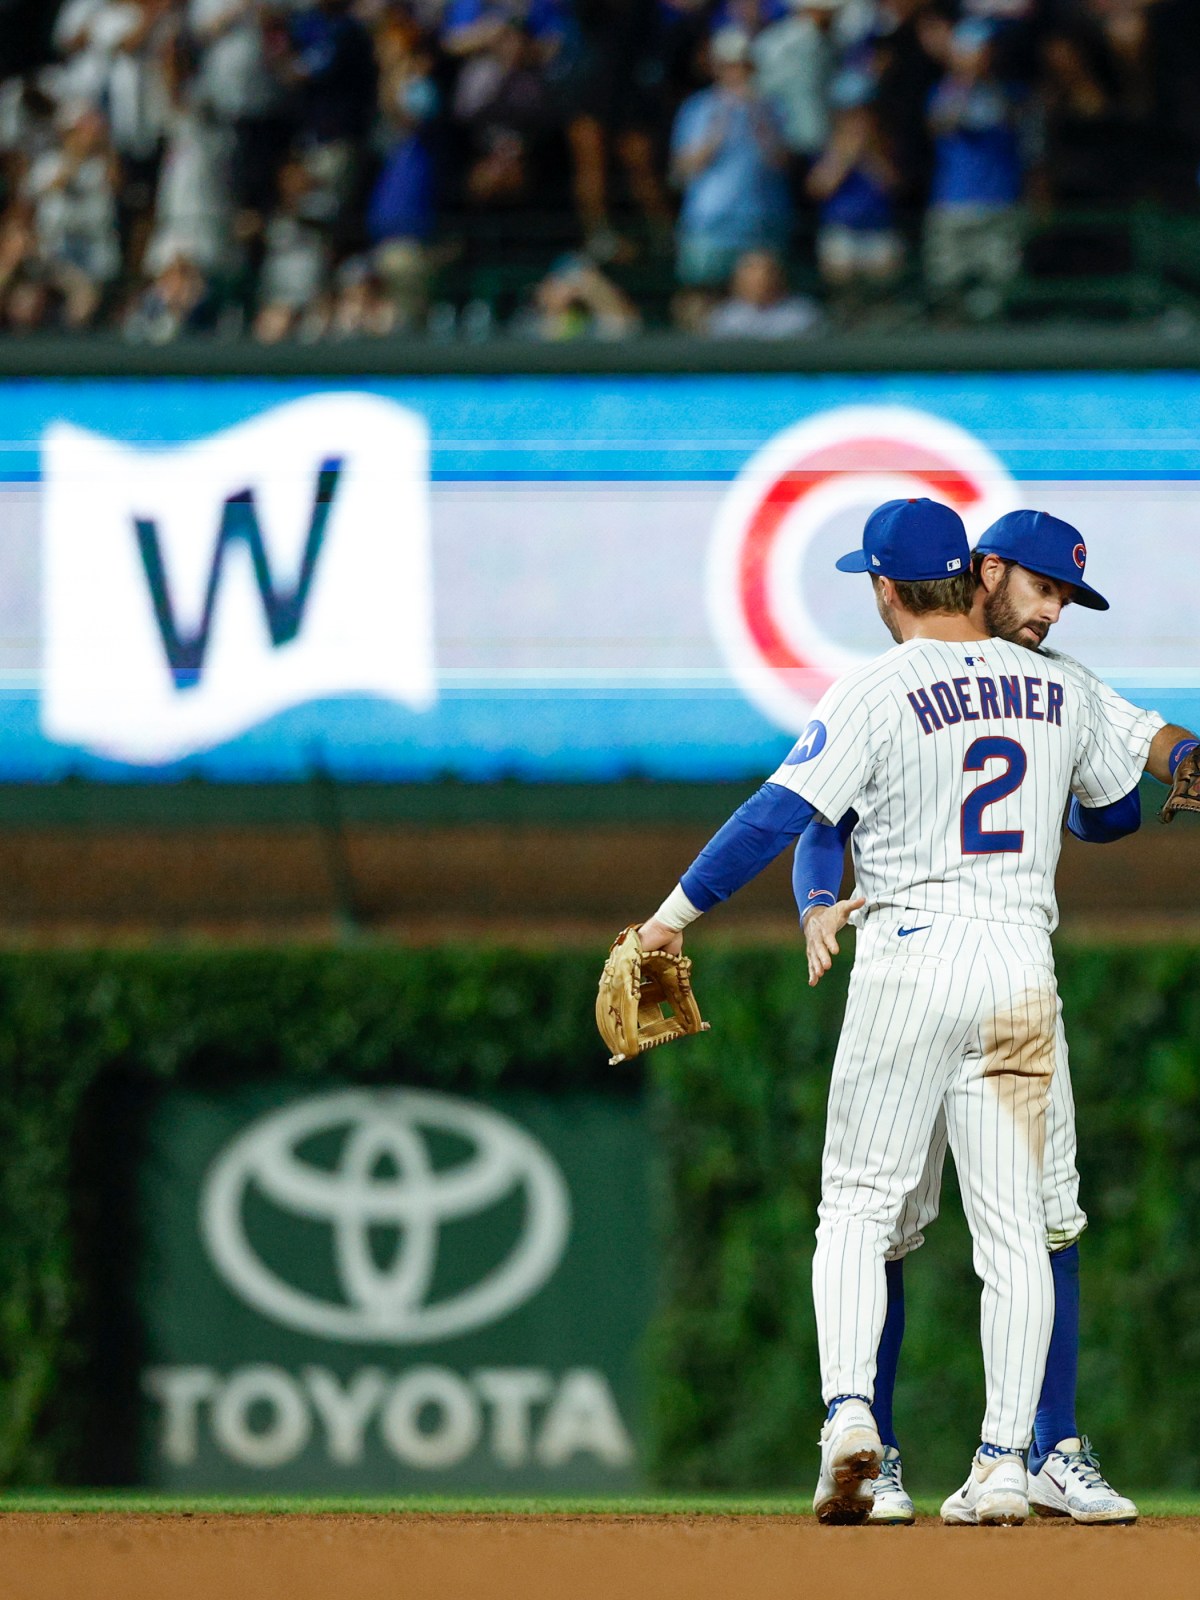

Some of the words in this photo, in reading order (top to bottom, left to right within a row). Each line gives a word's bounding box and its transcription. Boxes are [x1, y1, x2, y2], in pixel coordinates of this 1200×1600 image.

[132, 455, 346, 691] W
[906, 675, 1064, 735] HOERNER
[960, 735, 1028, 856] 2
[141, 1364, 634, 1469] TOYOTA
